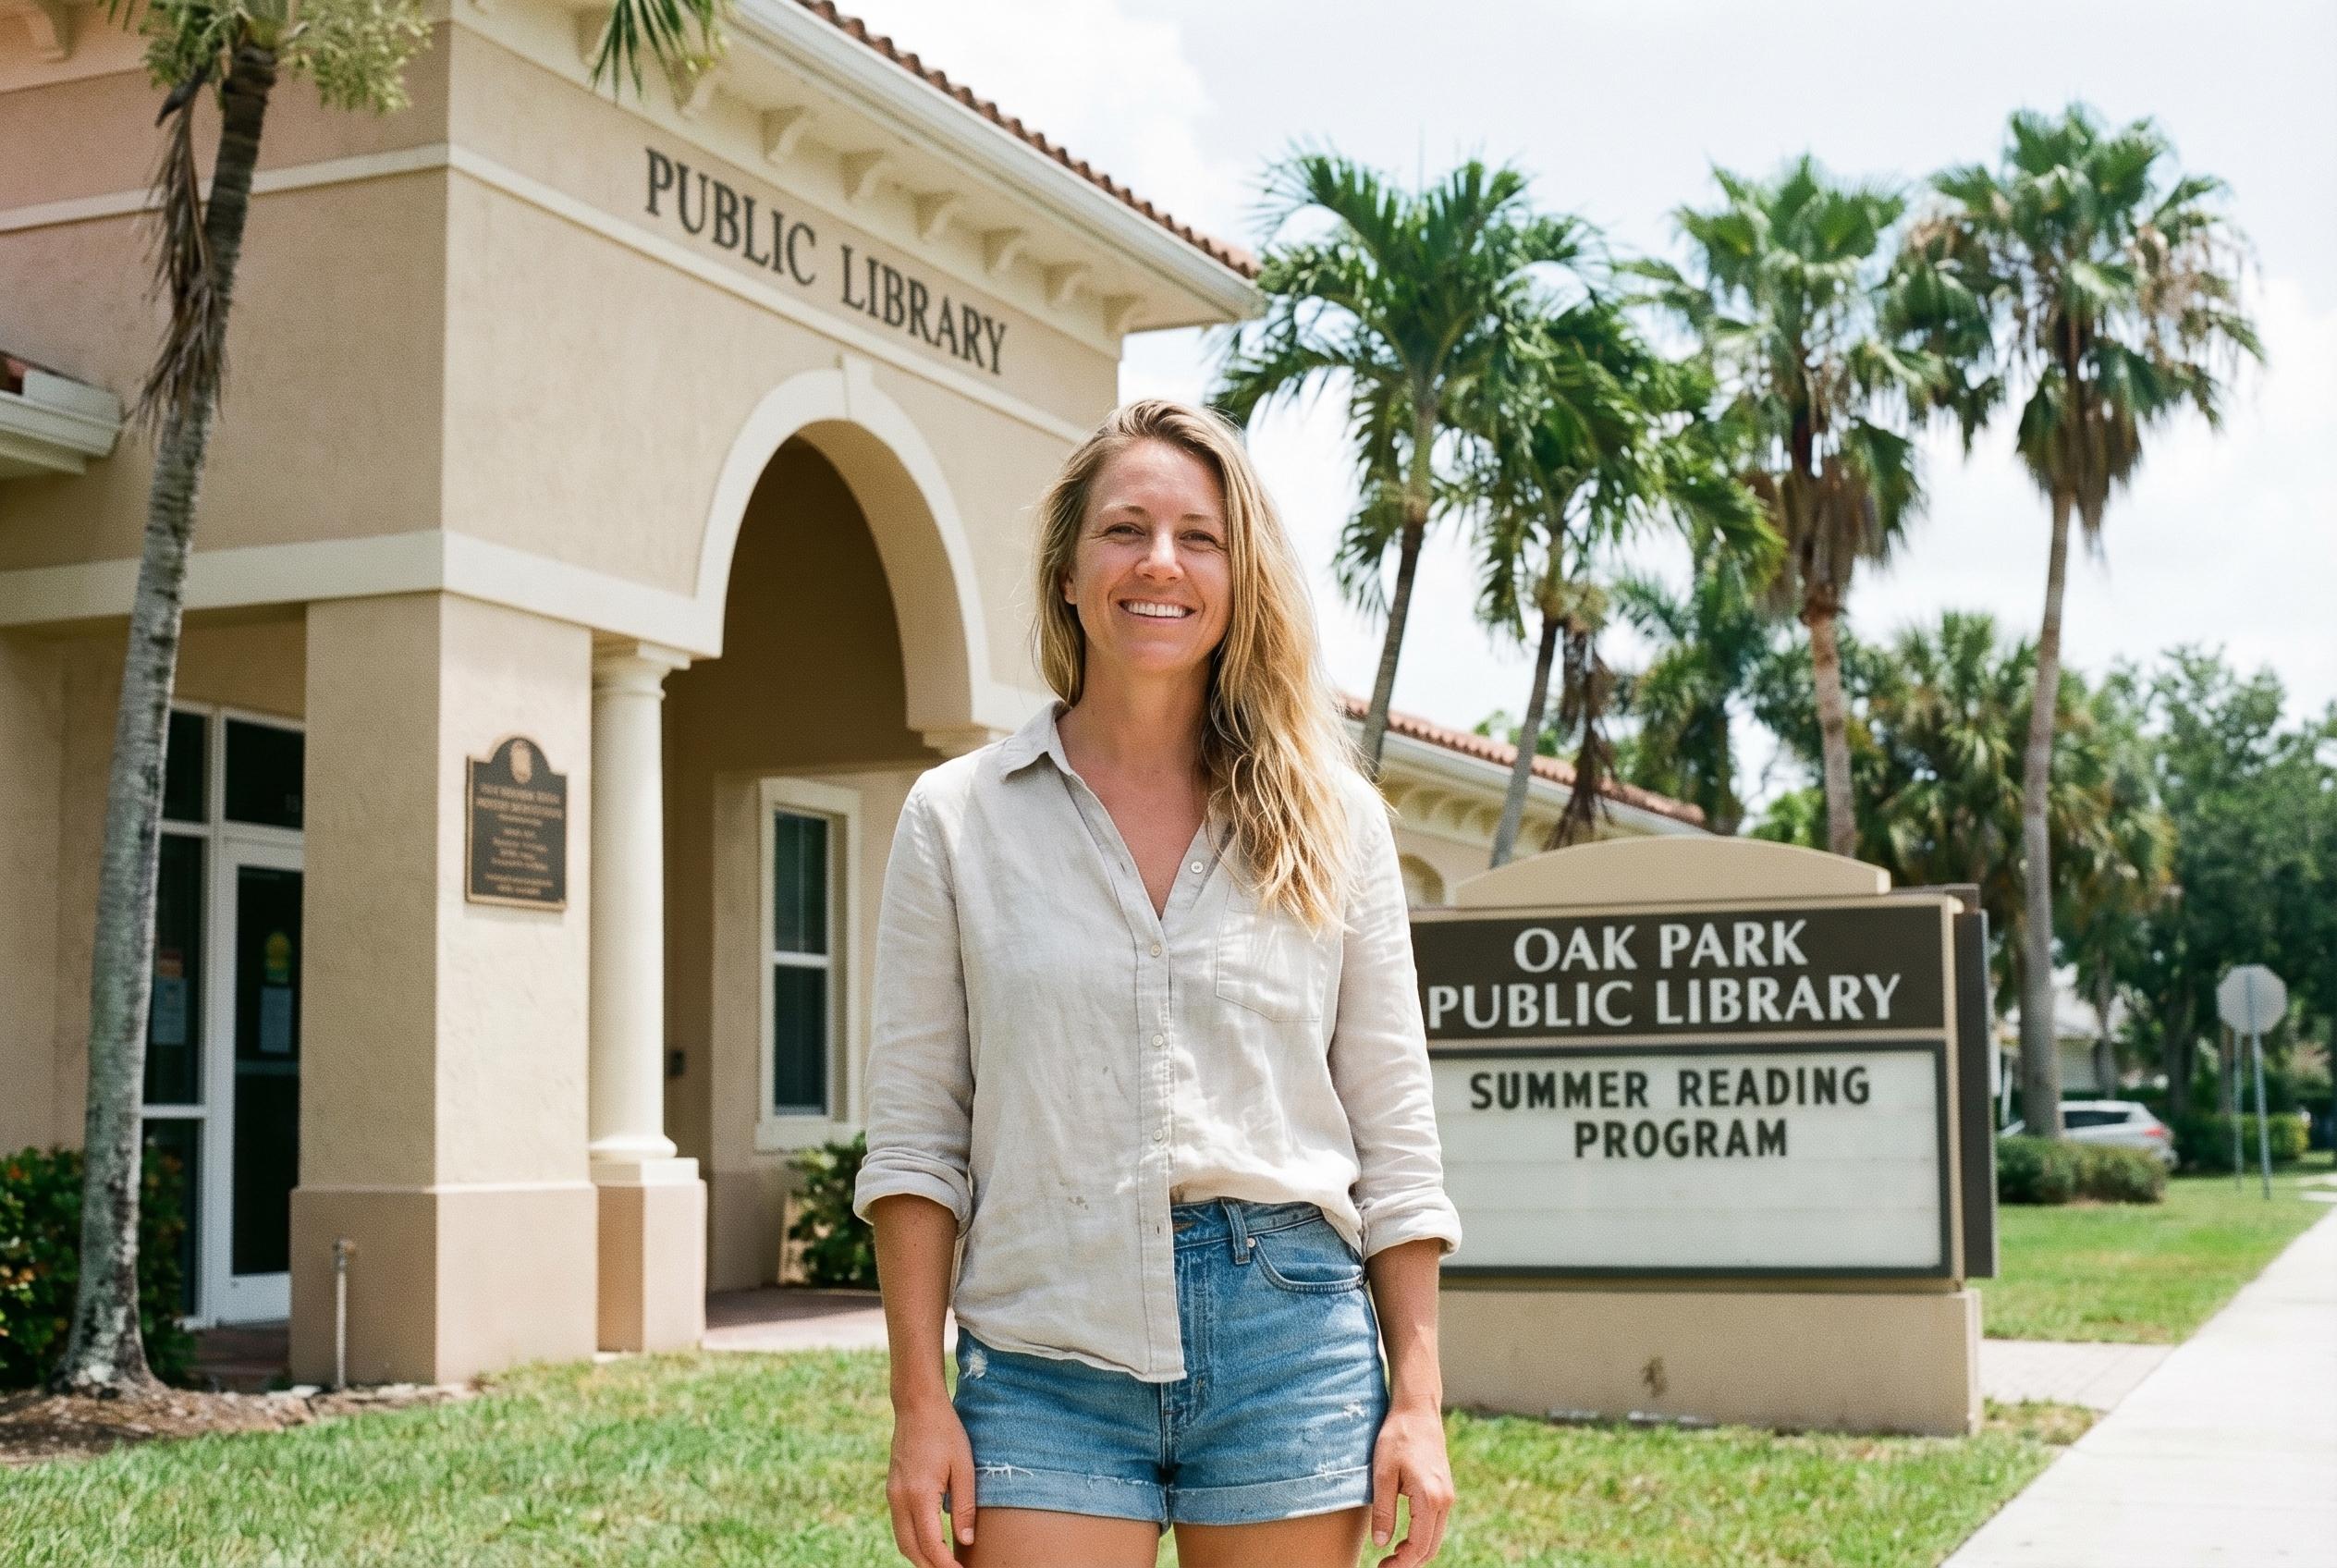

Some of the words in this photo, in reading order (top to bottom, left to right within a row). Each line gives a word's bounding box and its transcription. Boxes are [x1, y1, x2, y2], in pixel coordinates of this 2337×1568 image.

[645, 148, 816, 286] PUBLIC
[840, 244, 1007, 375] LIBRARY
[1513, 926, 1637, 974] OAK
[1658, 919, 1808, 969] PARK
[1428, 980, 1633, 1029] PUBLIC
[1656, 974, 1901, 1025] LIBRARY
[1469, 1070, 1649, 1111] SUMMER
[1678, 1065, 1870, 1109] READING
[1574, 1118, 1787, 1159] PROGRAM
